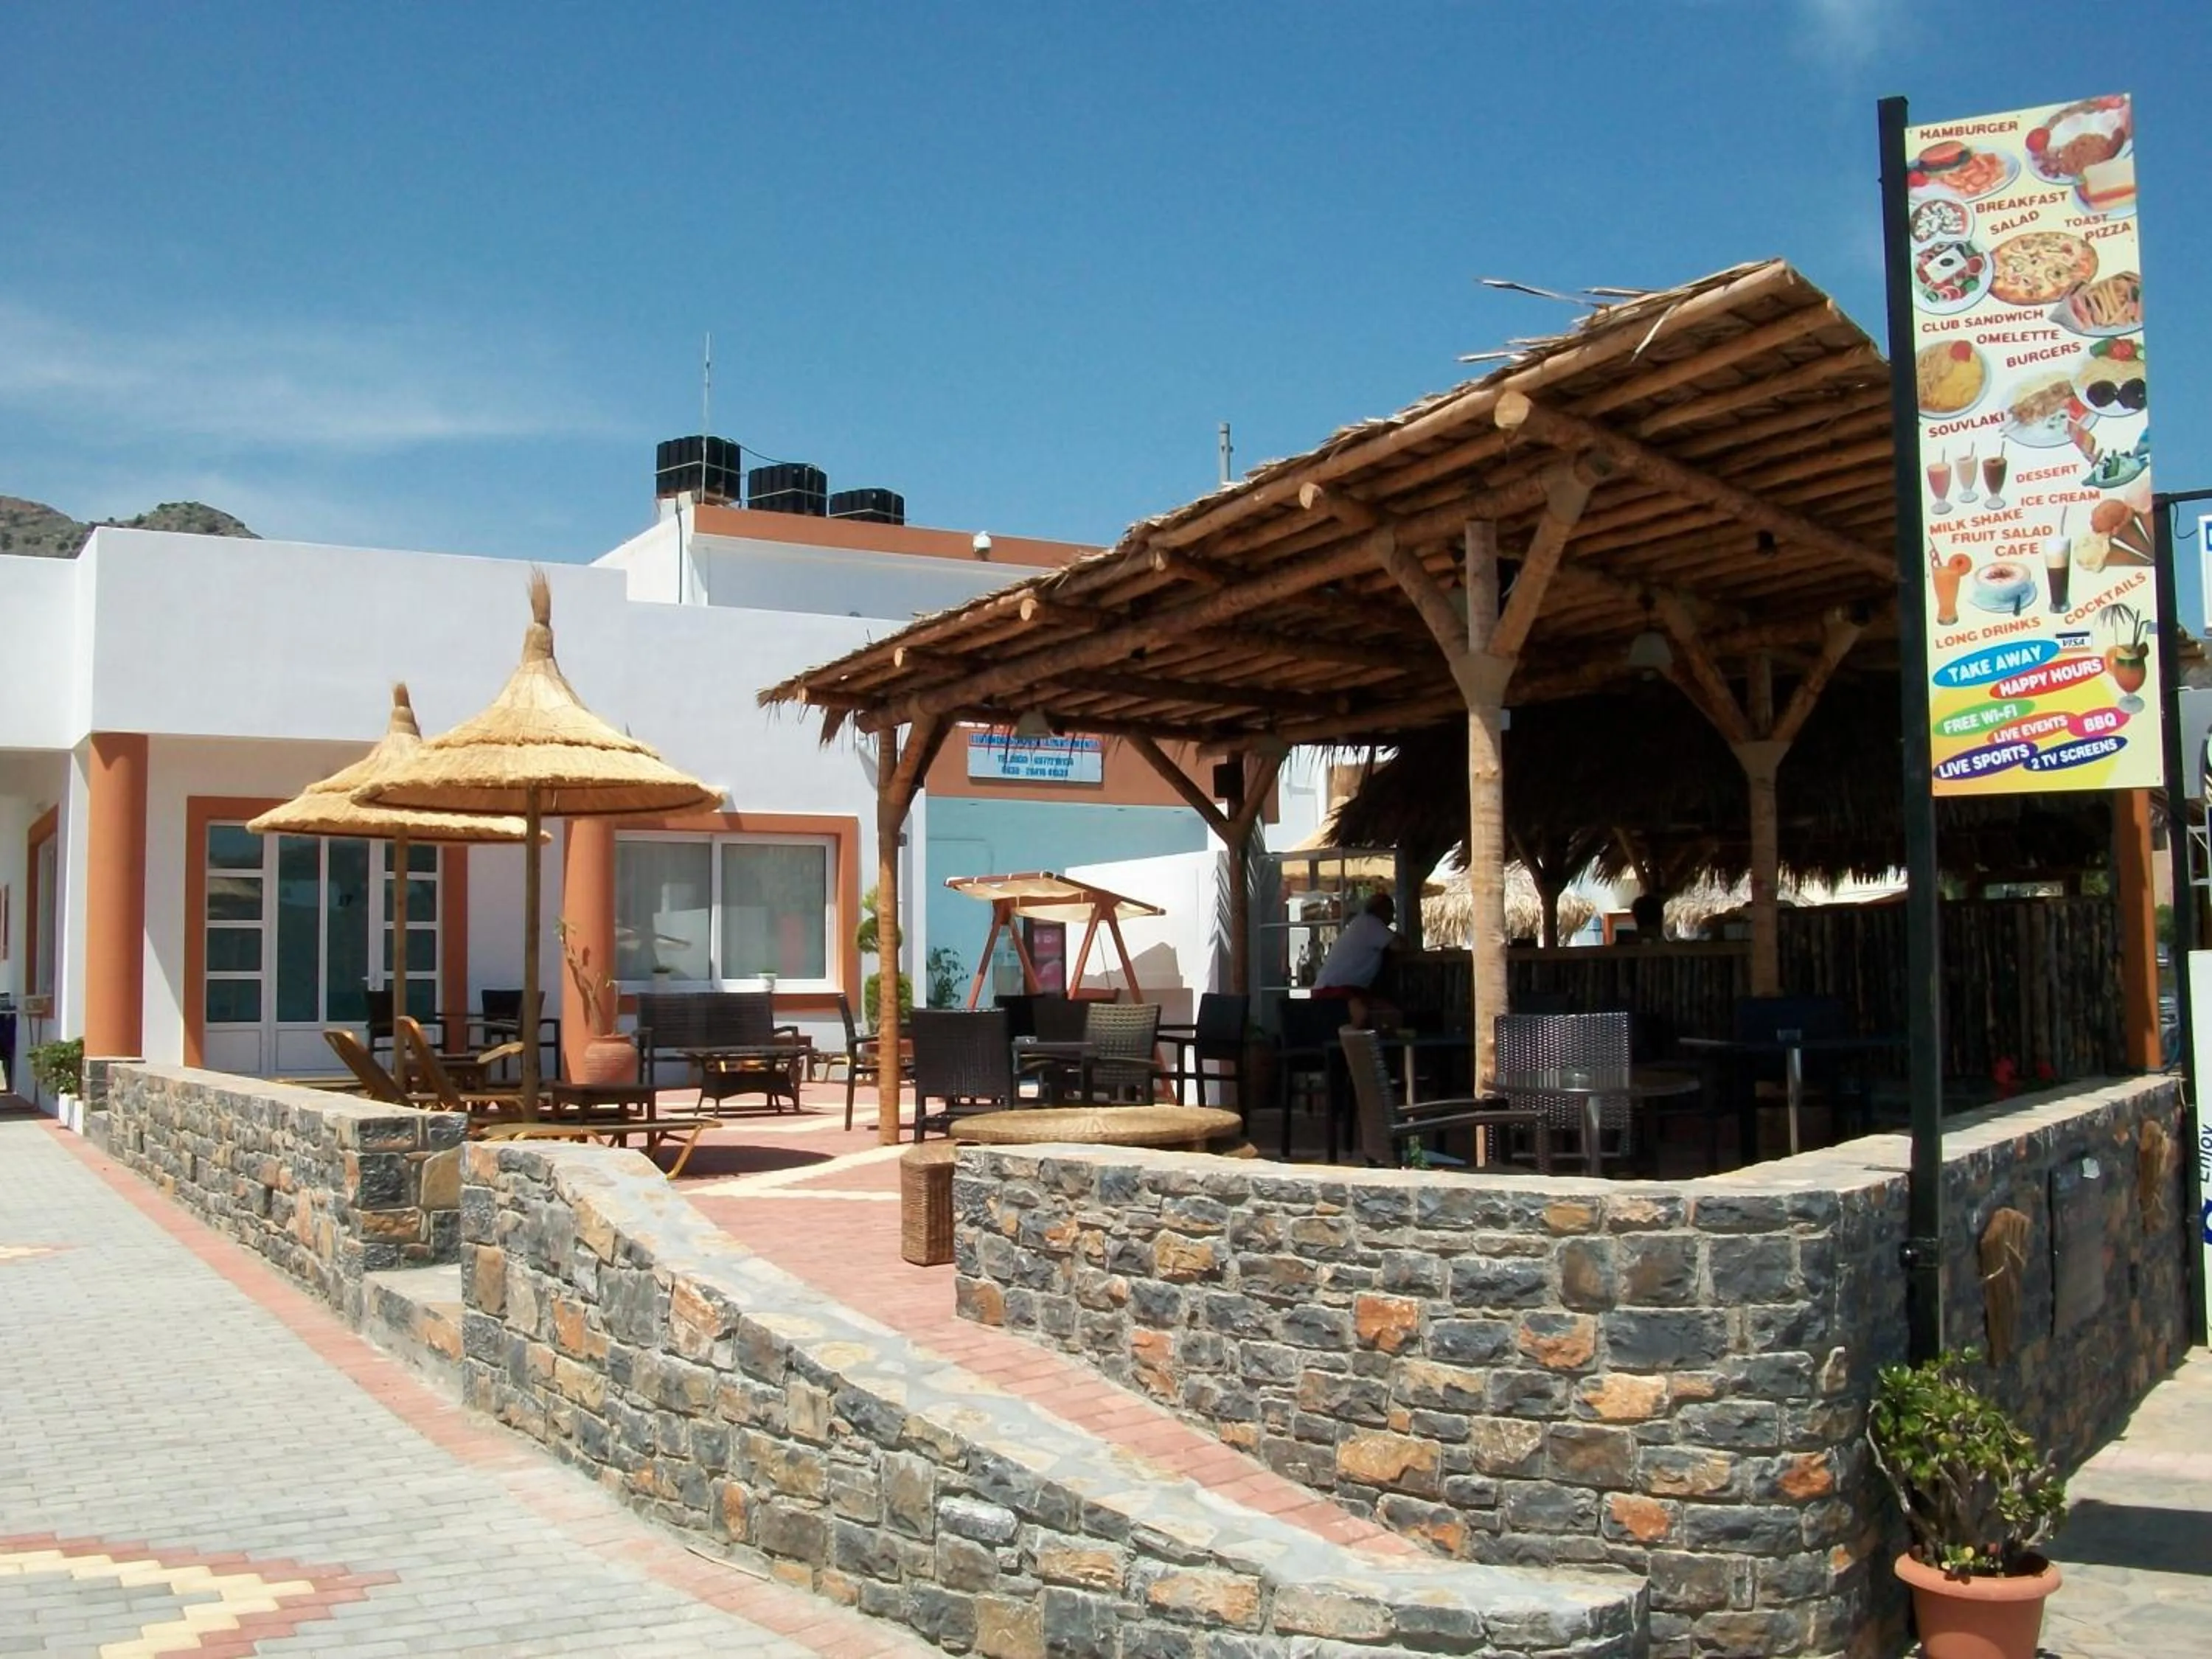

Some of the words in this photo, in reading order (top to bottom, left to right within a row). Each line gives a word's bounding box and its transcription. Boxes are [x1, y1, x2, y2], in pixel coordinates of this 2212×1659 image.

[1919, 121, 2018, 139] HAMBURGER
[1976, 191, 2068, 214] BREAKFAST
[1990, 210, 2040, 235] SALAD
[2065, 213, 2109, 227] TOAST
[2085, 222, 2131, 241] PIZZA
[1922, 319, 1960, 333] CLUB
[1965, 309, 2044, 328] SANDWICH
[1977, 330, 2059, 344] OMELETTE
[2006, 342, 2081, 367] BURGERS
[1928, 412, 2005, 437] SOUVLAKI
[2016, 464, 2079, 484] DESSERT
[2020, 494, 2045, 507] ICE
[2048, 490, 2101, 504] CREAM
[1930, 520, 1966, 535] MILK
[1971, 509, 2023, 527] SHAKE
[1952, 529, 1996, 544] FRUIT
[2002, 524, 2053, 540] SALAD
[1995, 543, 2040, 557] CAFE
[2064, 572, 2146, 625] COCKTAILS
[1935, 627, 1978, 649] LONG
[1982, 616, 2041, 639] DRINKS
[2062, 638, 2084, 647] VISA
[1947, 659, 1993, 682] TAKE
[1996, 644, 2042, 671] AWAY
[2000, 671, 2047, 697] HAPPY
[2050, 656, 2102, 684] HOURS
[1944, 714, 1979, 734] FREE
[1983, 703, 2018, 726] WI-FI
[1994, 727, 2020, 744] LIVE
[2022, 715, 2067, 737] EVENTS
[2083, 713, 2117, 733] BBQ
[1938, 759, 1970, 778] LIVE
[1974, 744, 2030, 771] SPORTS
[2031, 758, 2041, 769] 2
[2041, 754, 2056, 767] TV
[2059, 738, 2118, 764] SCREENS
